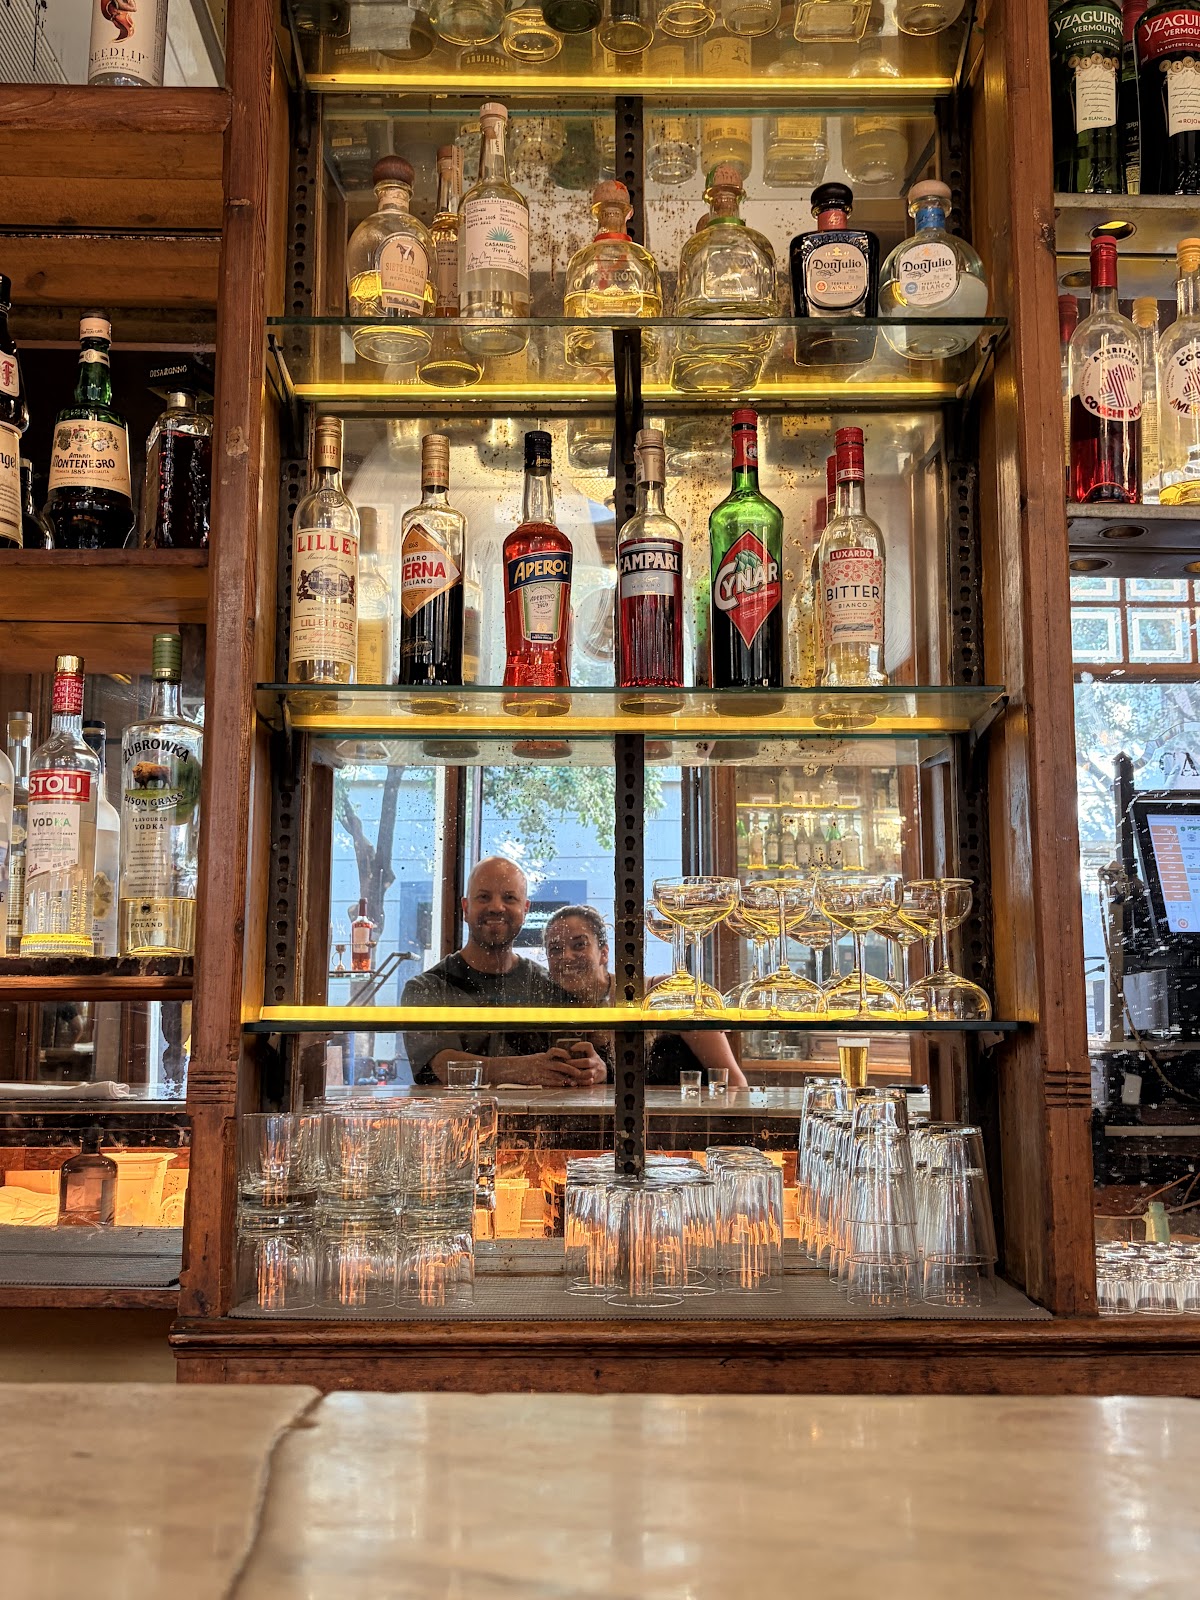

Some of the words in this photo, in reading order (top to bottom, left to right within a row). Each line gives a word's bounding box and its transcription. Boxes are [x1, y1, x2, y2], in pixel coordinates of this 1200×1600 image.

[1072, 24, 1116, 36] VERMOUTH
[1144, 13, 1200, 42] YZAGUI
[90, 47, 145, 64] SEEDLIP
[484, 241, 516, 251] CASAMIGOS
[921, 282, 951, 291] BLANCO
[149, 364, 188, 378] DISARONNO
[1084, 395, 1124, 418] COCCHI
[320, 444, 338, 455] LILLET
[52, 454, 115, 469] MONTENEGRO
[297, 534, 358, 557] LILLET
[831, 549, 872, 560] LUXARDO
[513, 559, 568, 585] APEROL
[715, 562, 778, 610] CYNAR
[826, 585, 880, 602] BITTER
[529, 593, 556, 602] APERITIVO
[300, 618, 329, 628] LILLET
[332, 619, 353, 632] ROSÉ
[29, 775, 81, 795] STOLI
[124, 793, 148, 806] BISON
[150, 791, 184, 806] GRASS
[32, 817, 72, 828] VODKA
